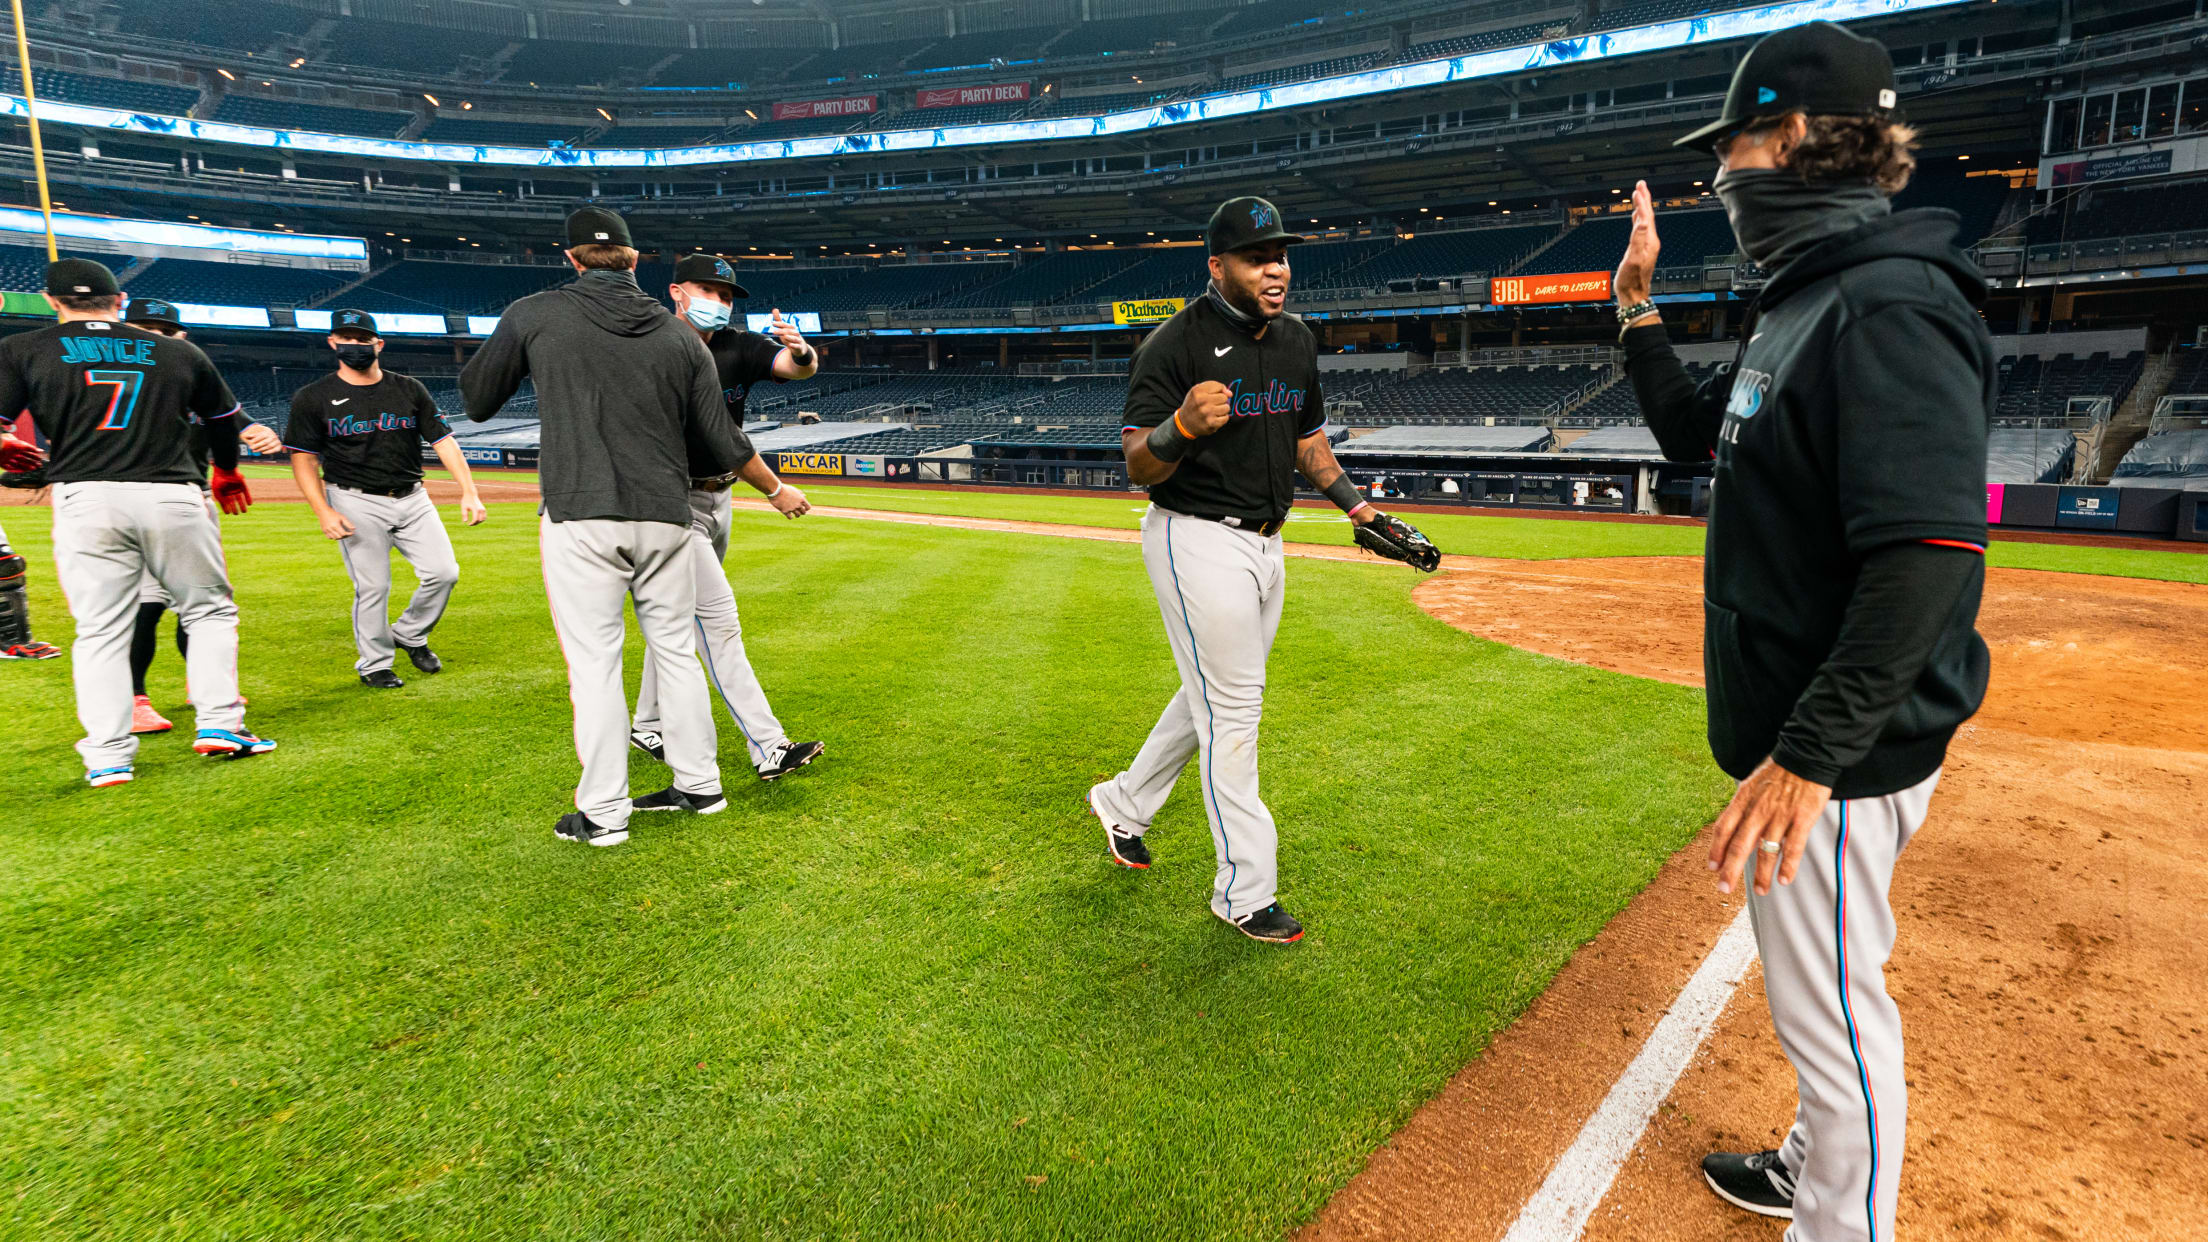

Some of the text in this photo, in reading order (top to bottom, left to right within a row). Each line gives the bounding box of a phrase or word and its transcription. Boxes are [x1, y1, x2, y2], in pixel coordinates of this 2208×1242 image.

[961, 88, 993, 103] PARTY
[995, 85, 1023, 100] DECK
[813, 101, 843, 116] PARTY
[845, 98, 871, 113] DECK
[1495, 279, 1531, 302] JBL
[1534, 284, 1558, 296] DARE
[1560, 284, 1569, 293] TO
[59, 336, 156, 366] JOYCE
[84, 369, 144, 430] 7
[462, 450, 500, 462] GEICO
[780, 454, 840, 470] PLYCAR
